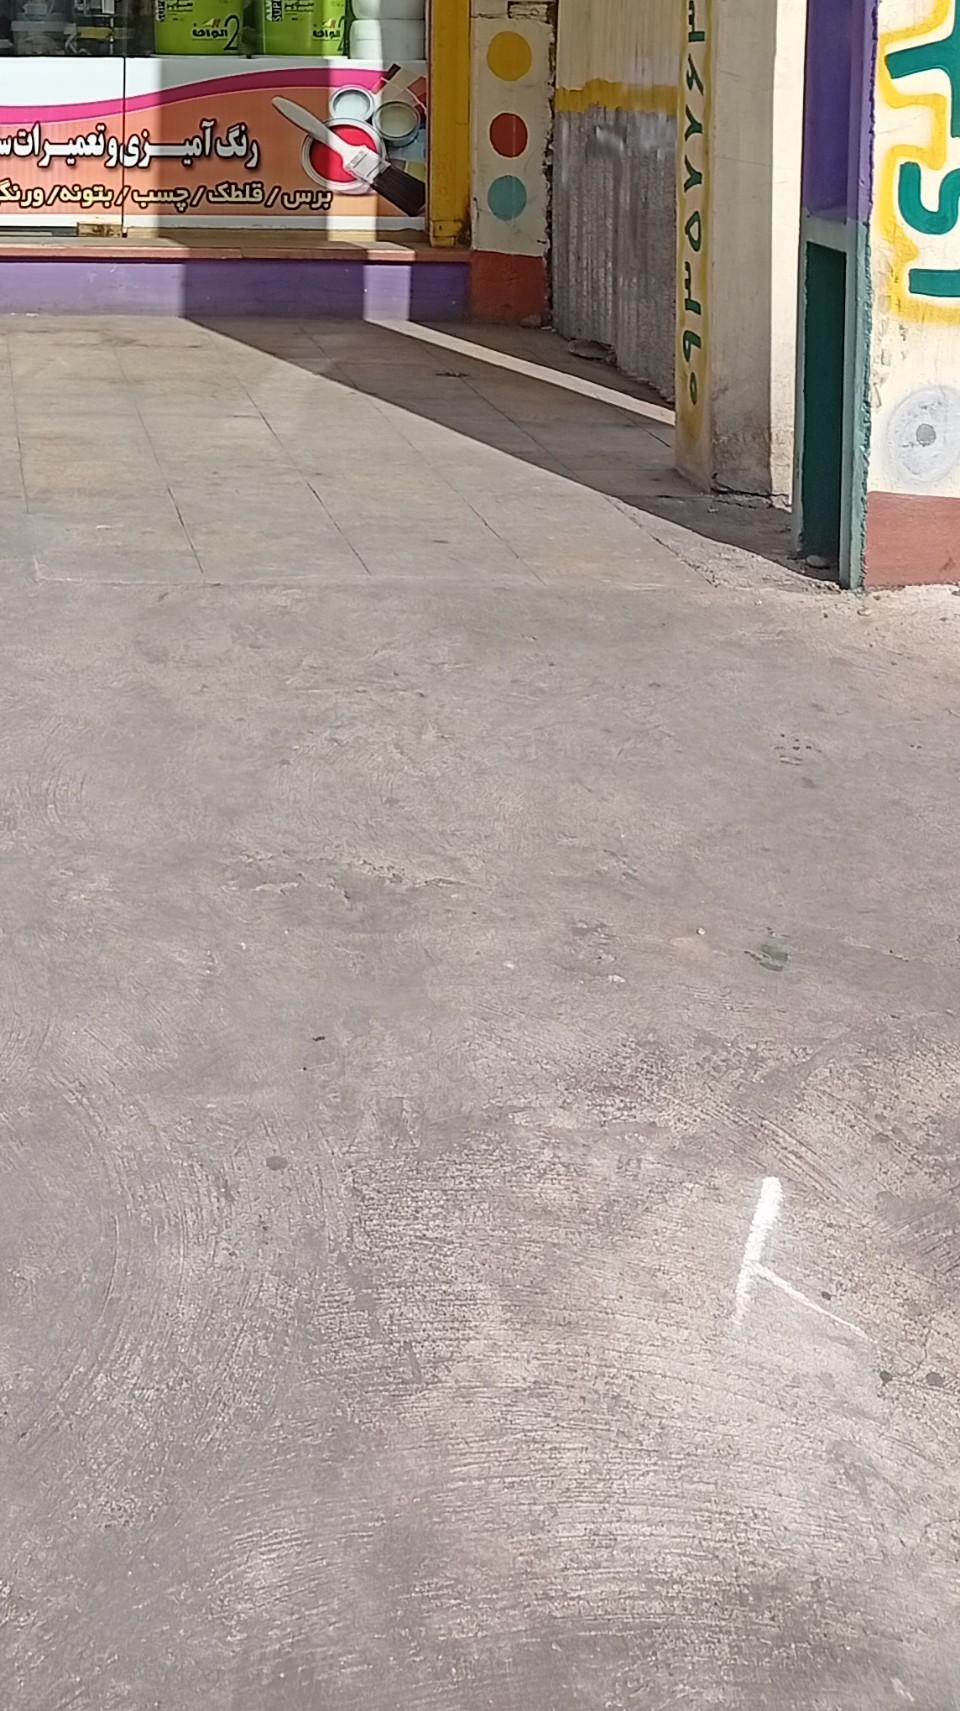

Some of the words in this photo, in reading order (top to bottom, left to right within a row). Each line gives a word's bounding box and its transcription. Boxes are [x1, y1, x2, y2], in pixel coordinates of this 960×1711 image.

[223, 14, 241, 51] 2
[17, 124, 106, 168] تعمیرات
[121, 119, 215, 168] آمیزی
[215, 122, 259, 168] رنگ
[59, 184, 114, 210] بتونه
[132, 185, 191, 212] چسب
[208, 182, 264, 204] قلطک
[283, 189, 333, 210] برس
